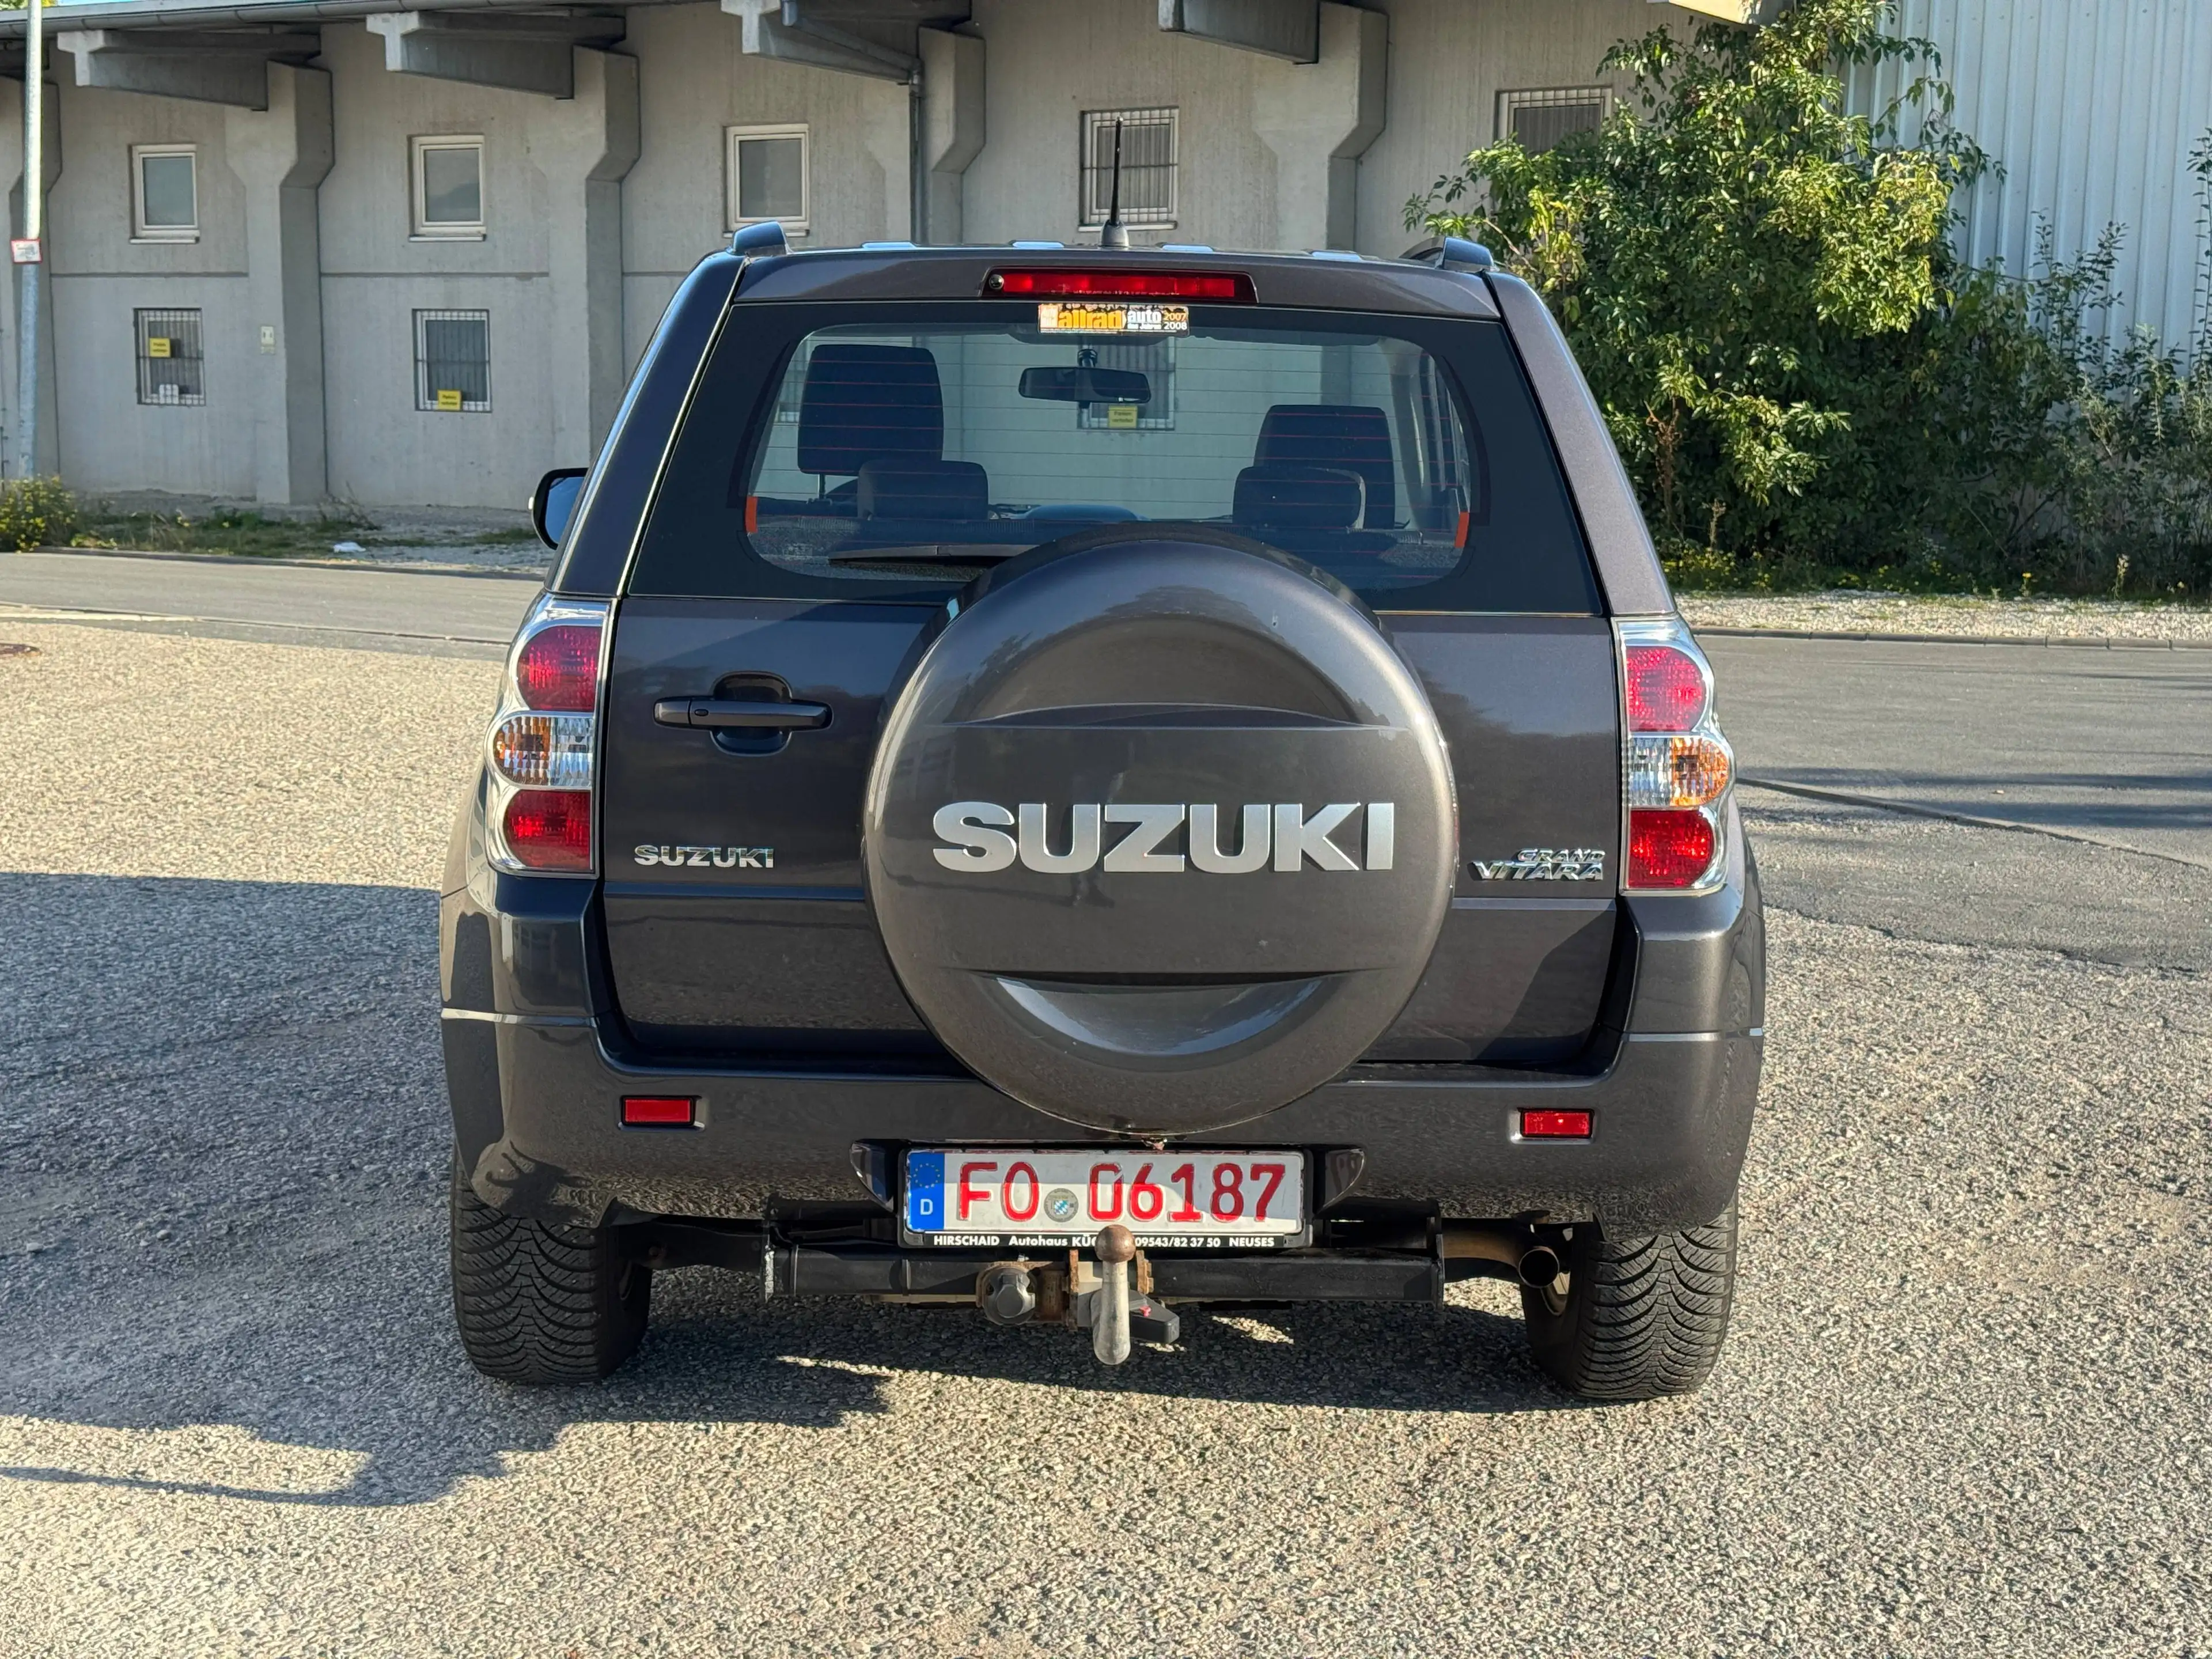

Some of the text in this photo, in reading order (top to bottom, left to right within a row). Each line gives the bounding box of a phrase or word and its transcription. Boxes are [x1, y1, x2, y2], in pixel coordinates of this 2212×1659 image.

[1058, 309, 1123, 329] allrad
[1127, 309, 1161, 323] auto
[1164, 312, 1187, 321] 2007
[1164, 322, 1188, 330] 2008
[933, 801, 1394, 873] SUZUKI
[634, 844, 774, 868] SUZUKI
[1517, 848, 1605, 862] GRAND
[1472, 861, 1603, 880] VITARA
[959, 1162, 1039, 1222] FO
[1087, 1162, 1286, 1222] 06187
[921, 1199, 933, 1215] D
[934, 1235, 1000, 1246] HIRSCHAID
[1009, 1236, 1068, 1246] Autohaus
[1135, 1237, 1187, 1247] 09543/82
[1190, 1237, 1202, 1247] 37
[1207, 1237, 1221, 1248] 50
[1229, 1237, 1275, 1247] NEUSES
